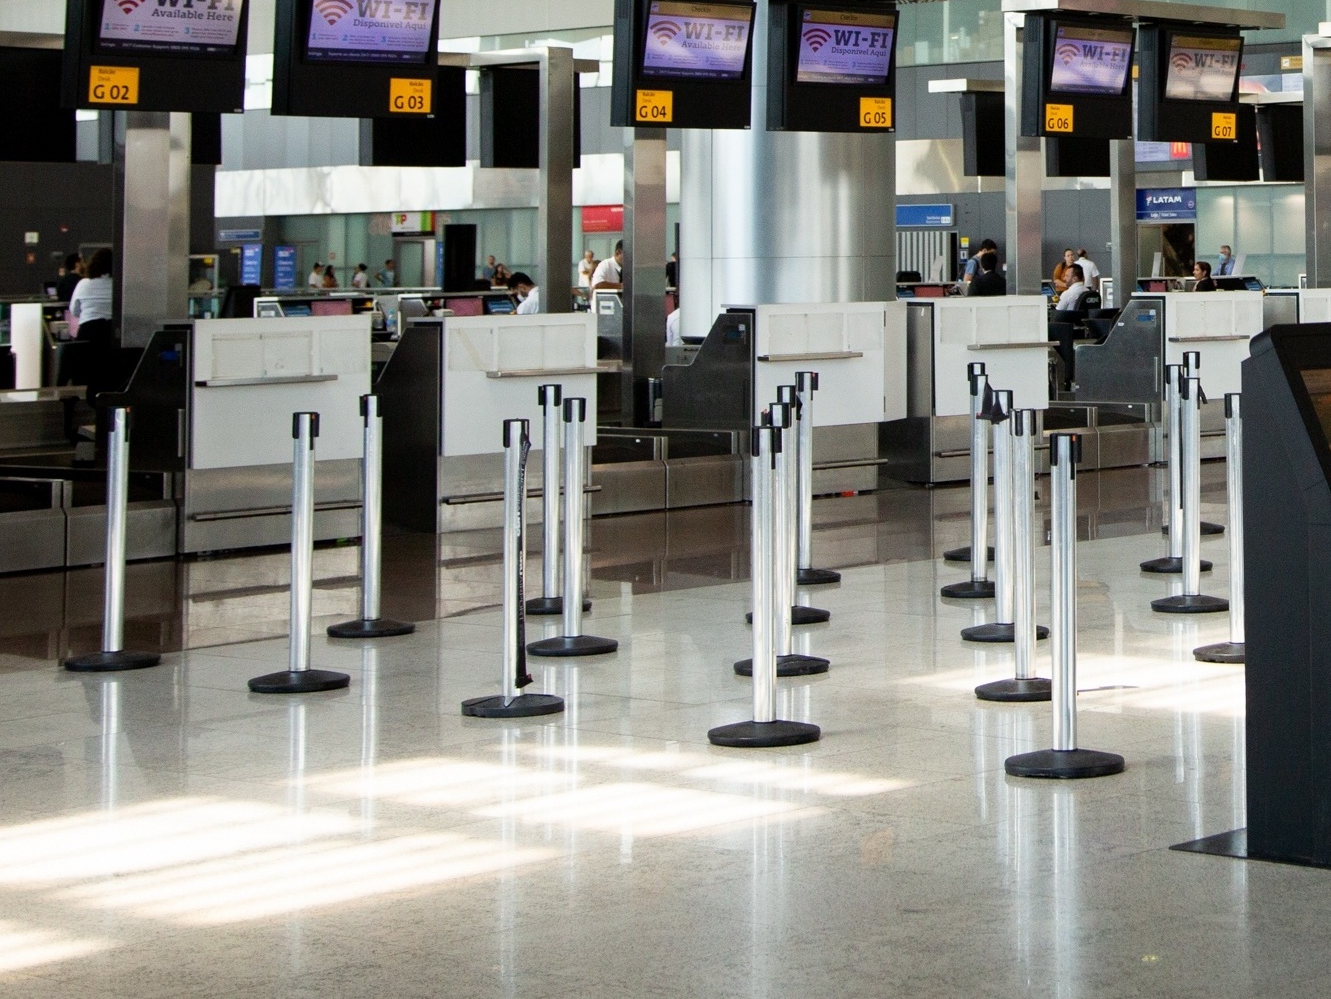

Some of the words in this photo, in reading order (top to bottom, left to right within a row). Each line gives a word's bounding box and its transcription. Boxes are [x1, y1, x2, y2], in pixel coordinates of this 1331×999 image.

[151, 8, 204, 20] Available
[206, 11, 234, 22] Here
[404, 21, 426, 30] Aqui
[684, 21, 745, 42] WI-FI
[681, 40, 720, 50] Available
[833, 29, 888, 48] WI-FI
[870, 49, 887, 58] Aqui
[1081, 44, 1128, 62] WI-FI
[1193, 52, 1236, 68] WI-FI
[93, 84, 104, 99] G
[109, 85, 130, 100] 02
[394, 95, 404, 109] G
[408, 95, 424, 110] 03
[639, 105, 648, 118] G
[651, 105, 667, 118] 04
[863, 112, 871, 124] G
[873, 112, 886, 124] 05
[1047, 118, 1055, 129] G
[1057, 118, 1069, 129] 06
[1214, 125, 1220, 136] G
[1222, 126, 1232, 137] 07
[1152, 196, 1182, 204] LATAM
